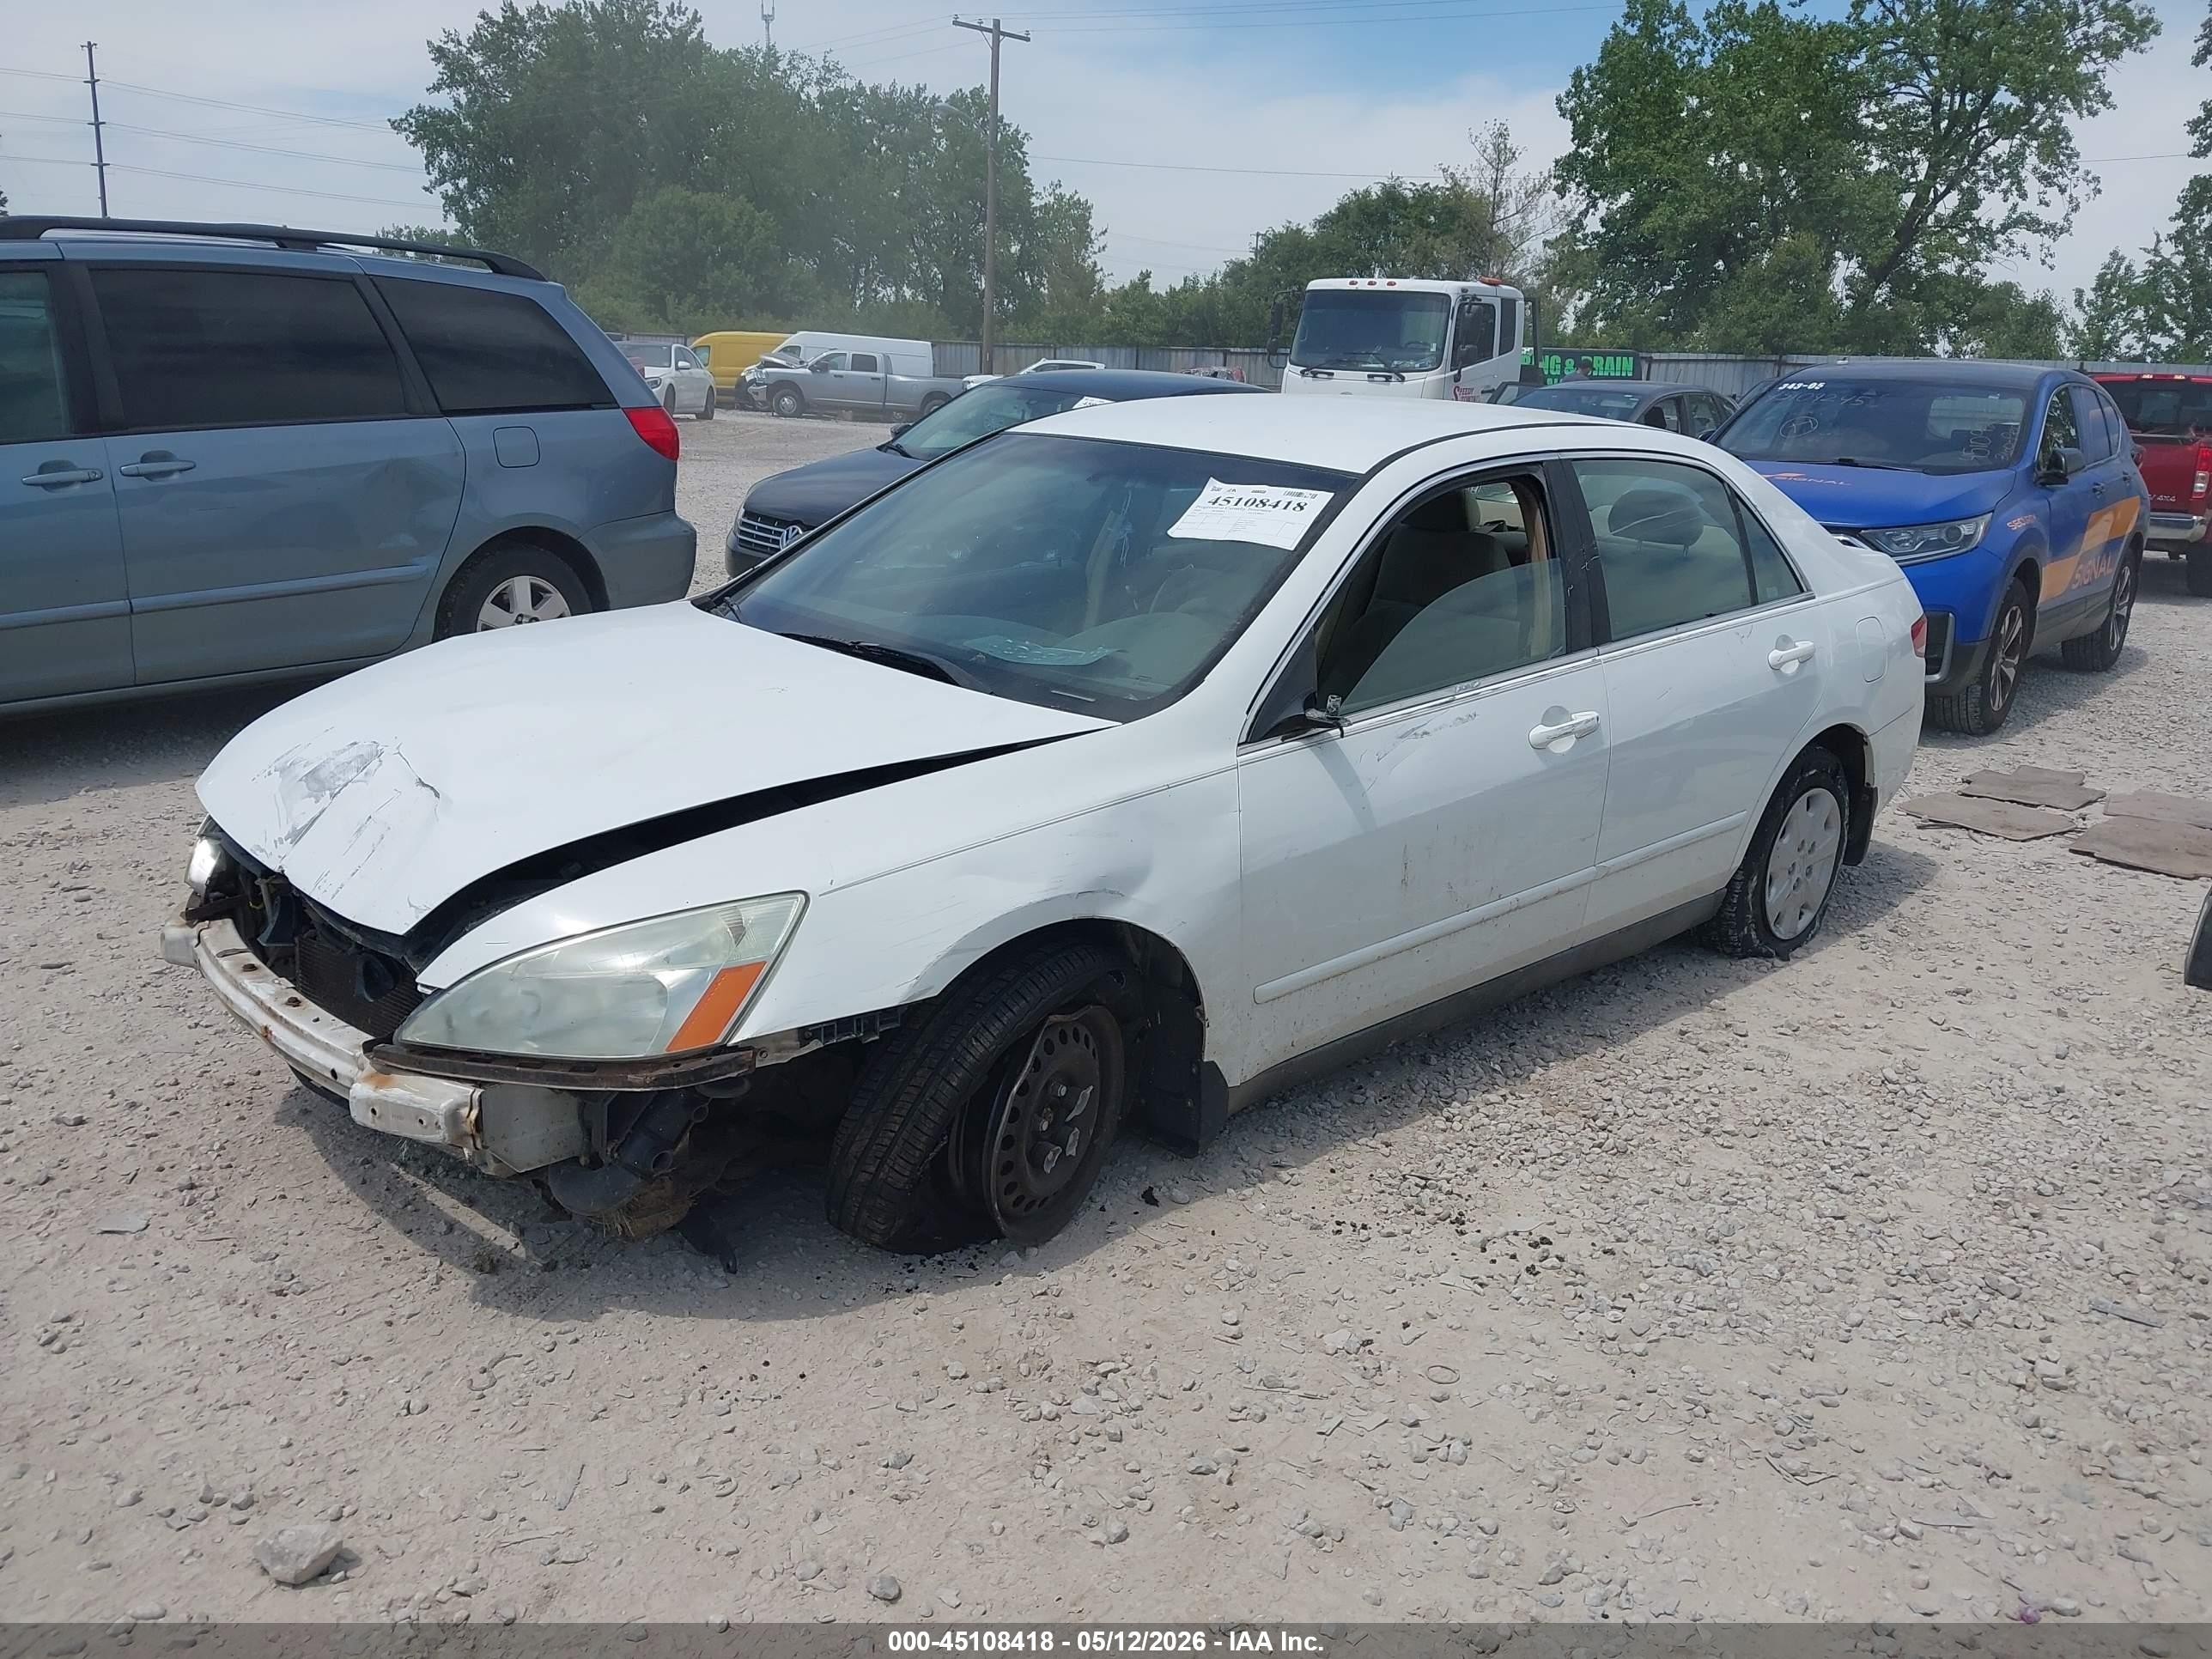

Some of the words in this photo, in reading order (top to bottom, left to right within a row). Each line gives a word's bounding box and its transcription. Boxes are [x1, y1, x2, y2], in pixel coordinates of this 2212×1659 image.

[1778, 382, 1826, 391] 343-05
[1207, 495, 1309, 513] 45108418
[2071, 555, 2114, 590] SIGNAL
